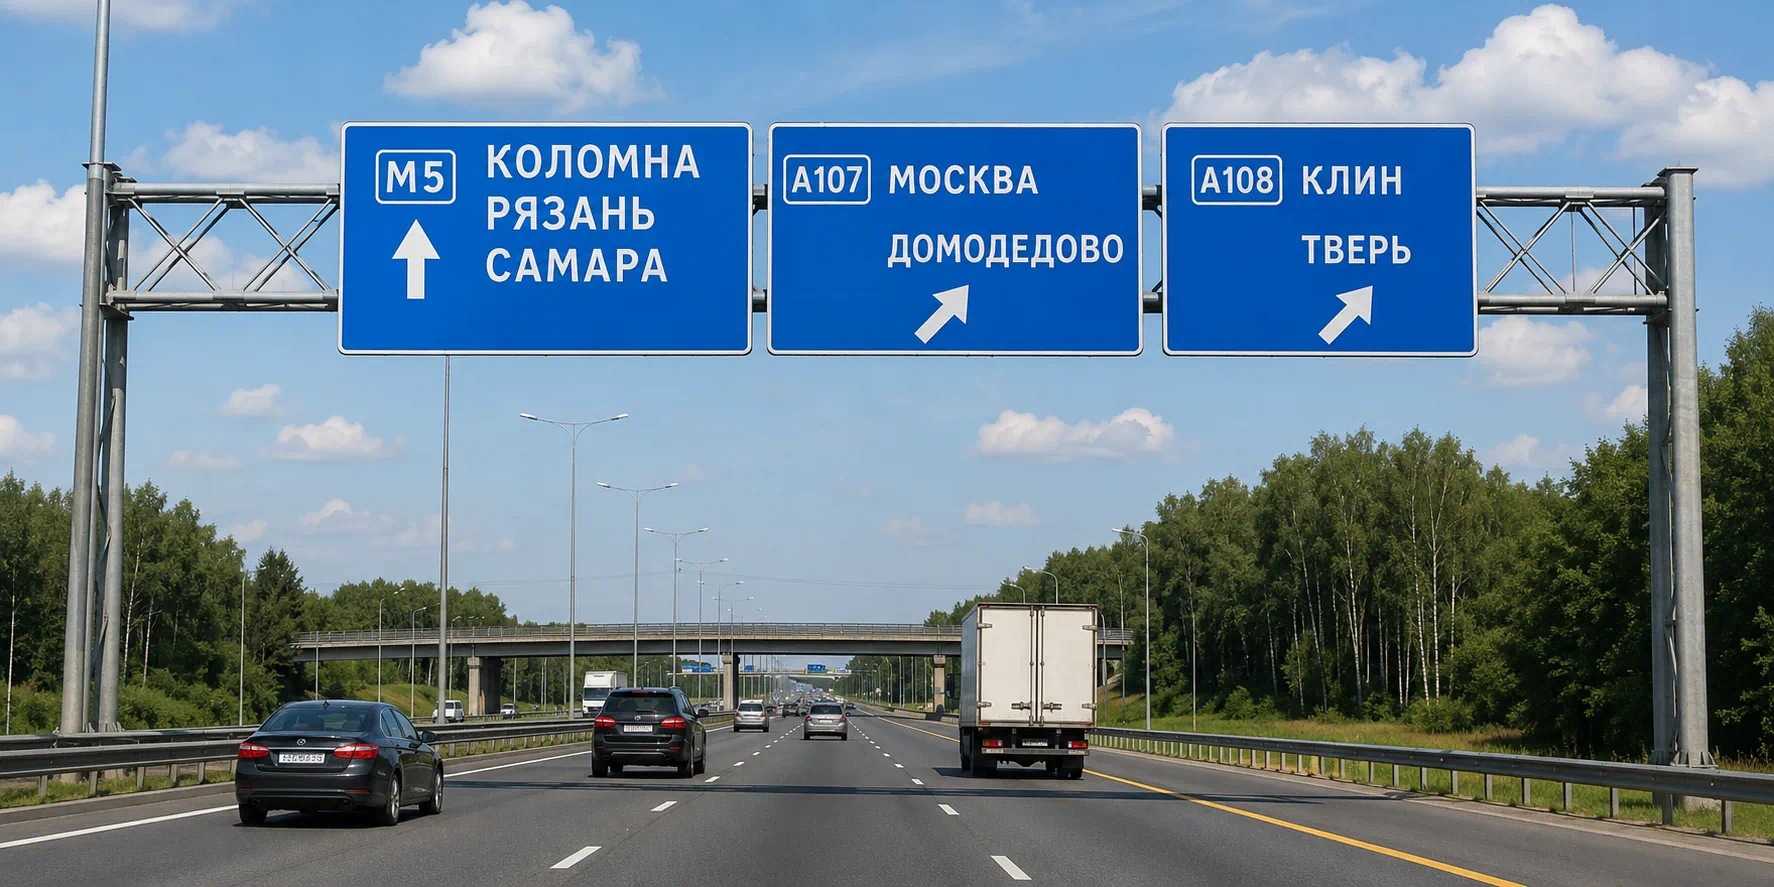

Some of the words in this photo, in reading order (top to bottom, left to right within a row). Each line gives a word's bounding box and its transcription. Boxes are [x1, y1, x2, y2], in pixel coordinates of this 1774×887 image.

[387, 160, 444, 193] М5
[487, 144, 700, 179] КОЛОМНА
[791, 165, 863, 194] А107
[889, 164, 1039, 195] МОСКВА
[1200, 166, 1274, 194] А108
[1302, 165, 1402, 195] КЛИН
[487, 195, 655, 231] РЯЗАНЬ
[486, 247, 668, 283] САМАРА
[887, 233, 1124, 269] ДОМОДЕДОВО
[1301, 234, 1411, 264] ТВЕРЬ
